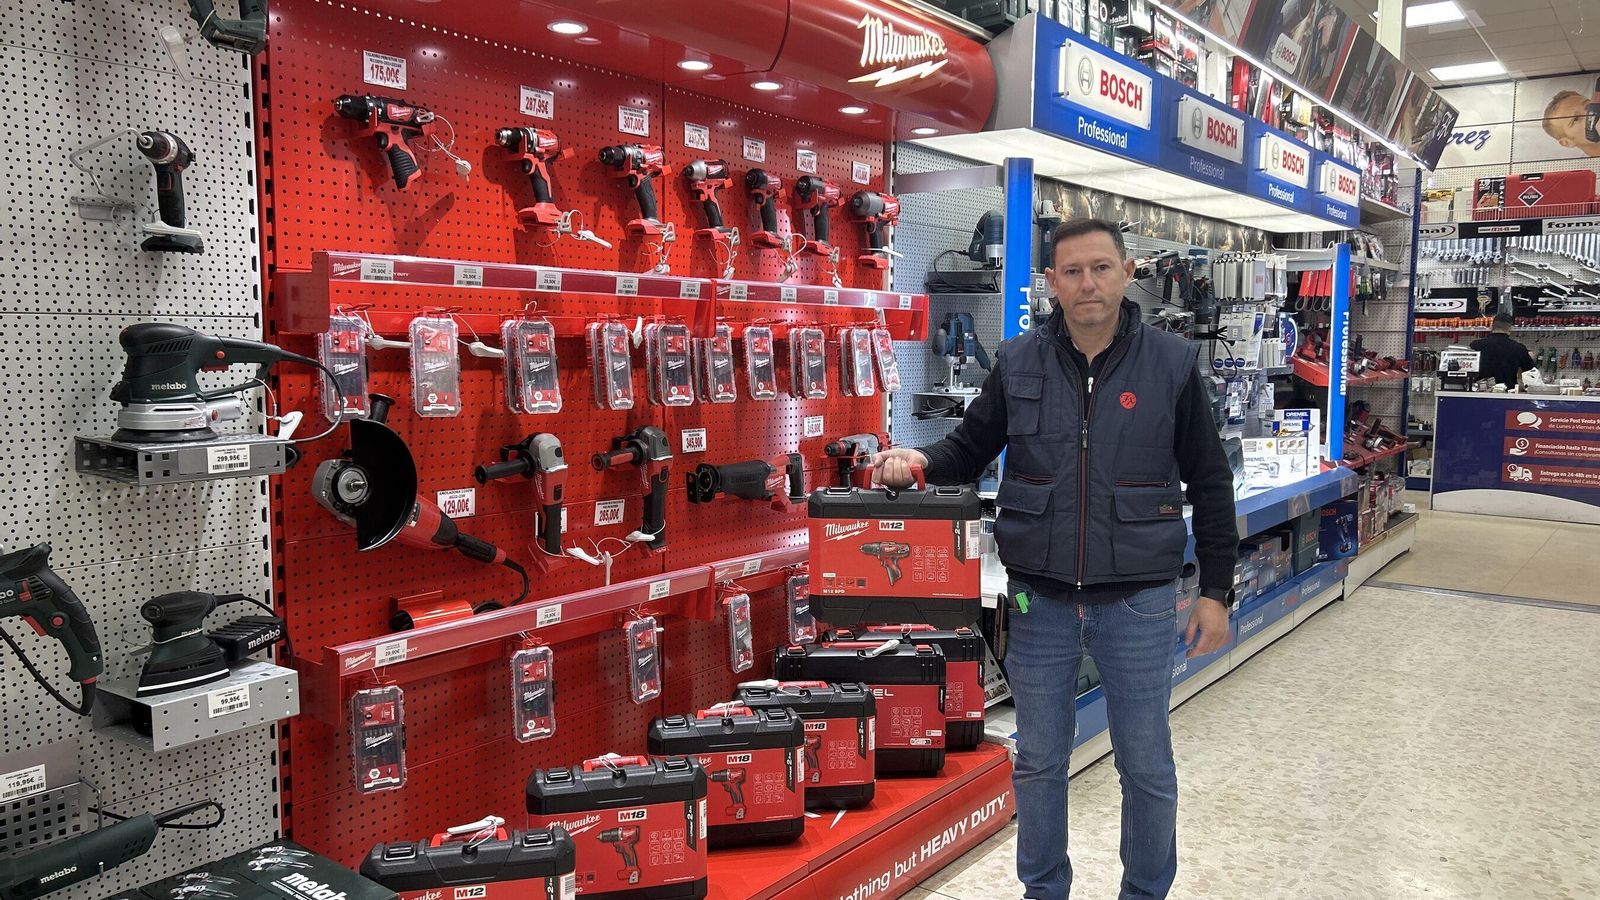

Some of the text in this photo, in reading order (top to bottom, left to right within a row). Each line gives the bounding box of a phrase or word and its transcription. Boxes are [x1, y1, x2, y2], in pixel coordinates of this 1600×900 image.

[857, 12, 947, 67] Milwaukee
[1282, 47, 1297, 65] BOSCH
[371, 64, 399, 83] 175,00€
[1100, 70, 1143, 111] BOSCH
[1078, 116, 1128, 149] Professional
[1207, 116, 1238, 149] BOSCH
[1190, 156, 1225, 181] Professional
[1283, 150, 1304, 176] BOSCH
[1269, 183, 1295, 203] Professional
[1339, 175, 1356, 196] BOSCH
[1327, 204, 1348, 219] Professional
[151, 382, 187, 390] metabo
[217, 455, 240, 463] 299,95€
[444, 498, 470, 515] 129,00€
[824, 521, 870, 537] Milwaukee
[880, 522, 903, 530] M12
[1240, 613, 1264, 635] Professional
[248, 628, 281, 649] metabo
[220, 696, 241, 704] 99,95€
[805, 722, 825, 730] M18
[728, 754, 750, 763] M18
[8, 777, 35, 789] 119,95€
[619, 810, 645, 820] M18
[894, 852, 917, 880] but
[920, 816, 968, 862] HEAVY
[40, 865, 78, 884] metabo
[456, 887, 484, 898] M12
